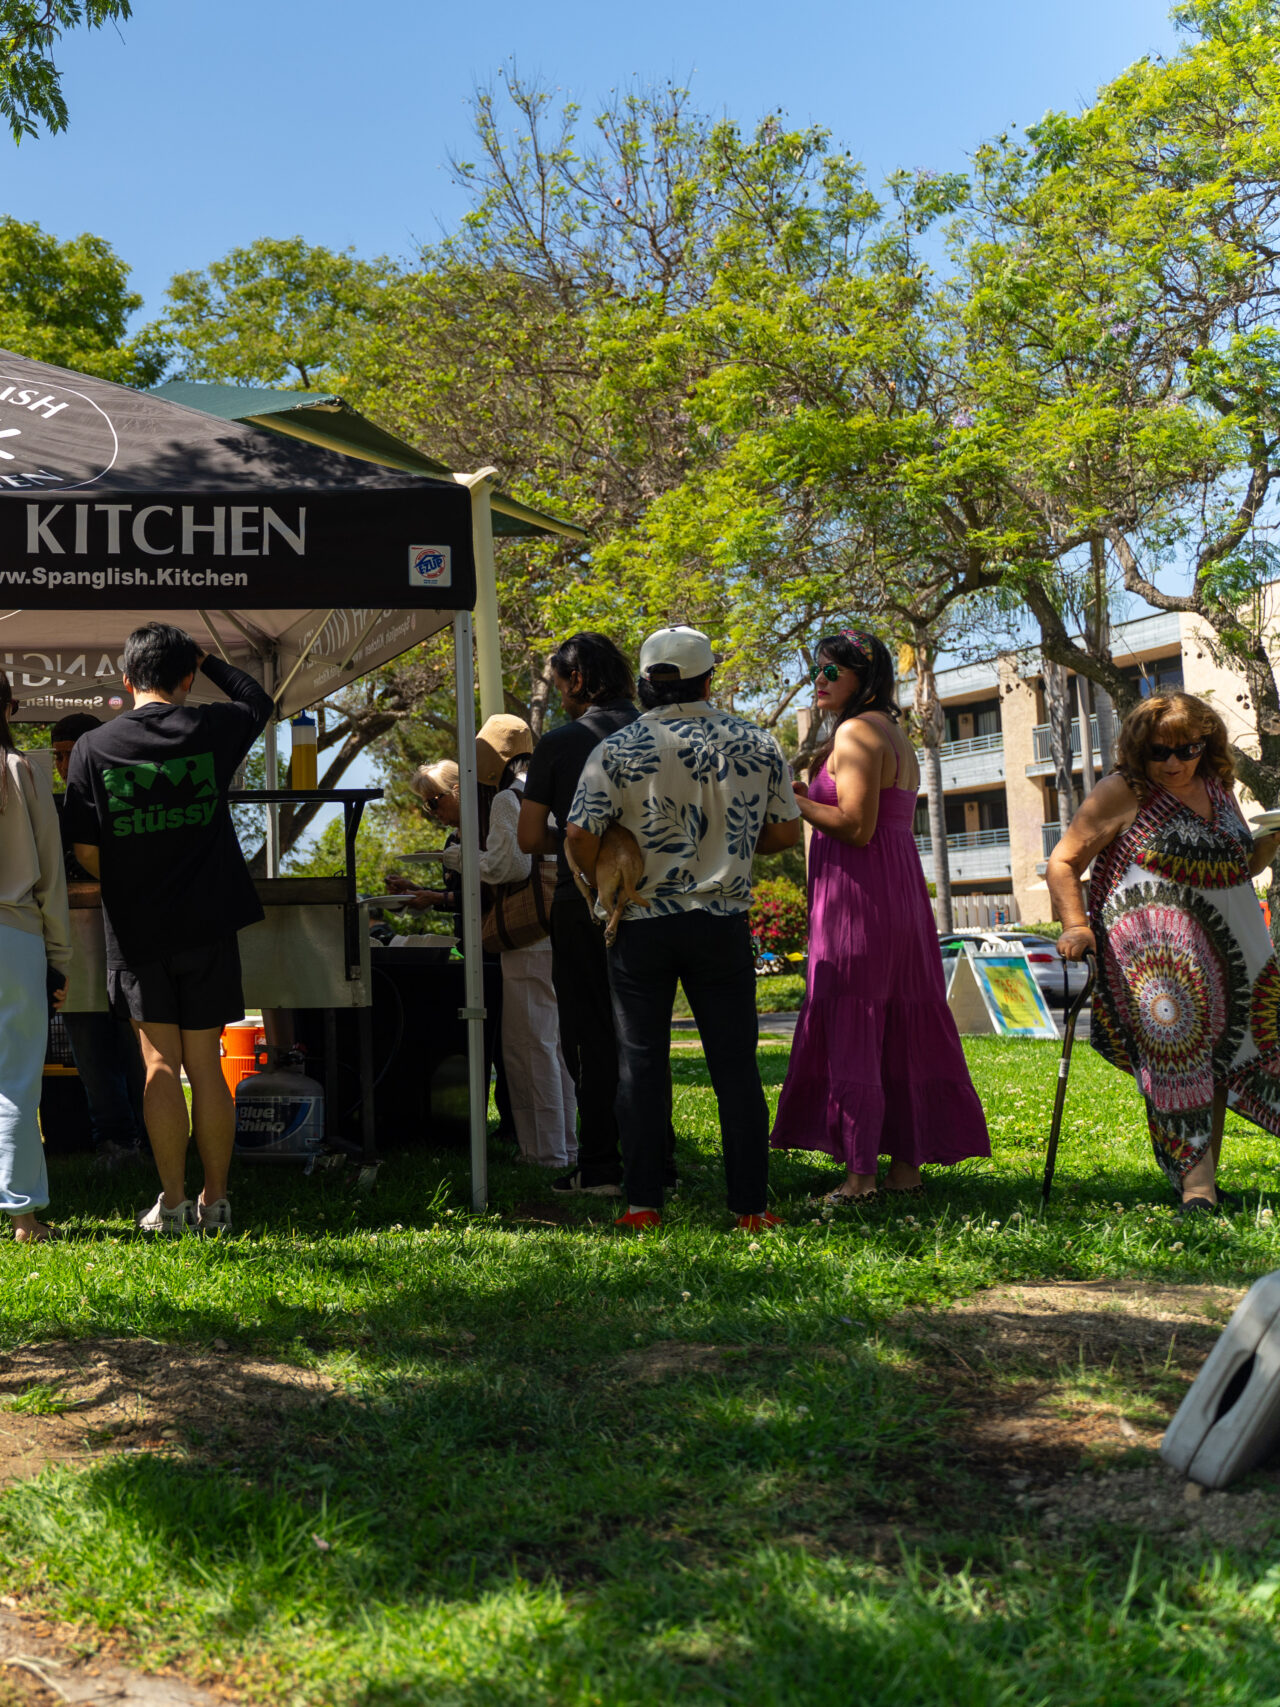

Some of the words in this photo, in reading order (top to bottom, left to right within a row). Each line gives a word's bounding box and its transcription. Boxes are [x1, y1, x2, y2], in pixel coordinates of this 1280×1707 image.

[27, 504, 306, 556] KITCHEN
[113, 799, 218, 837] stüssy
[240, 1106, 275, 1119] Blue
